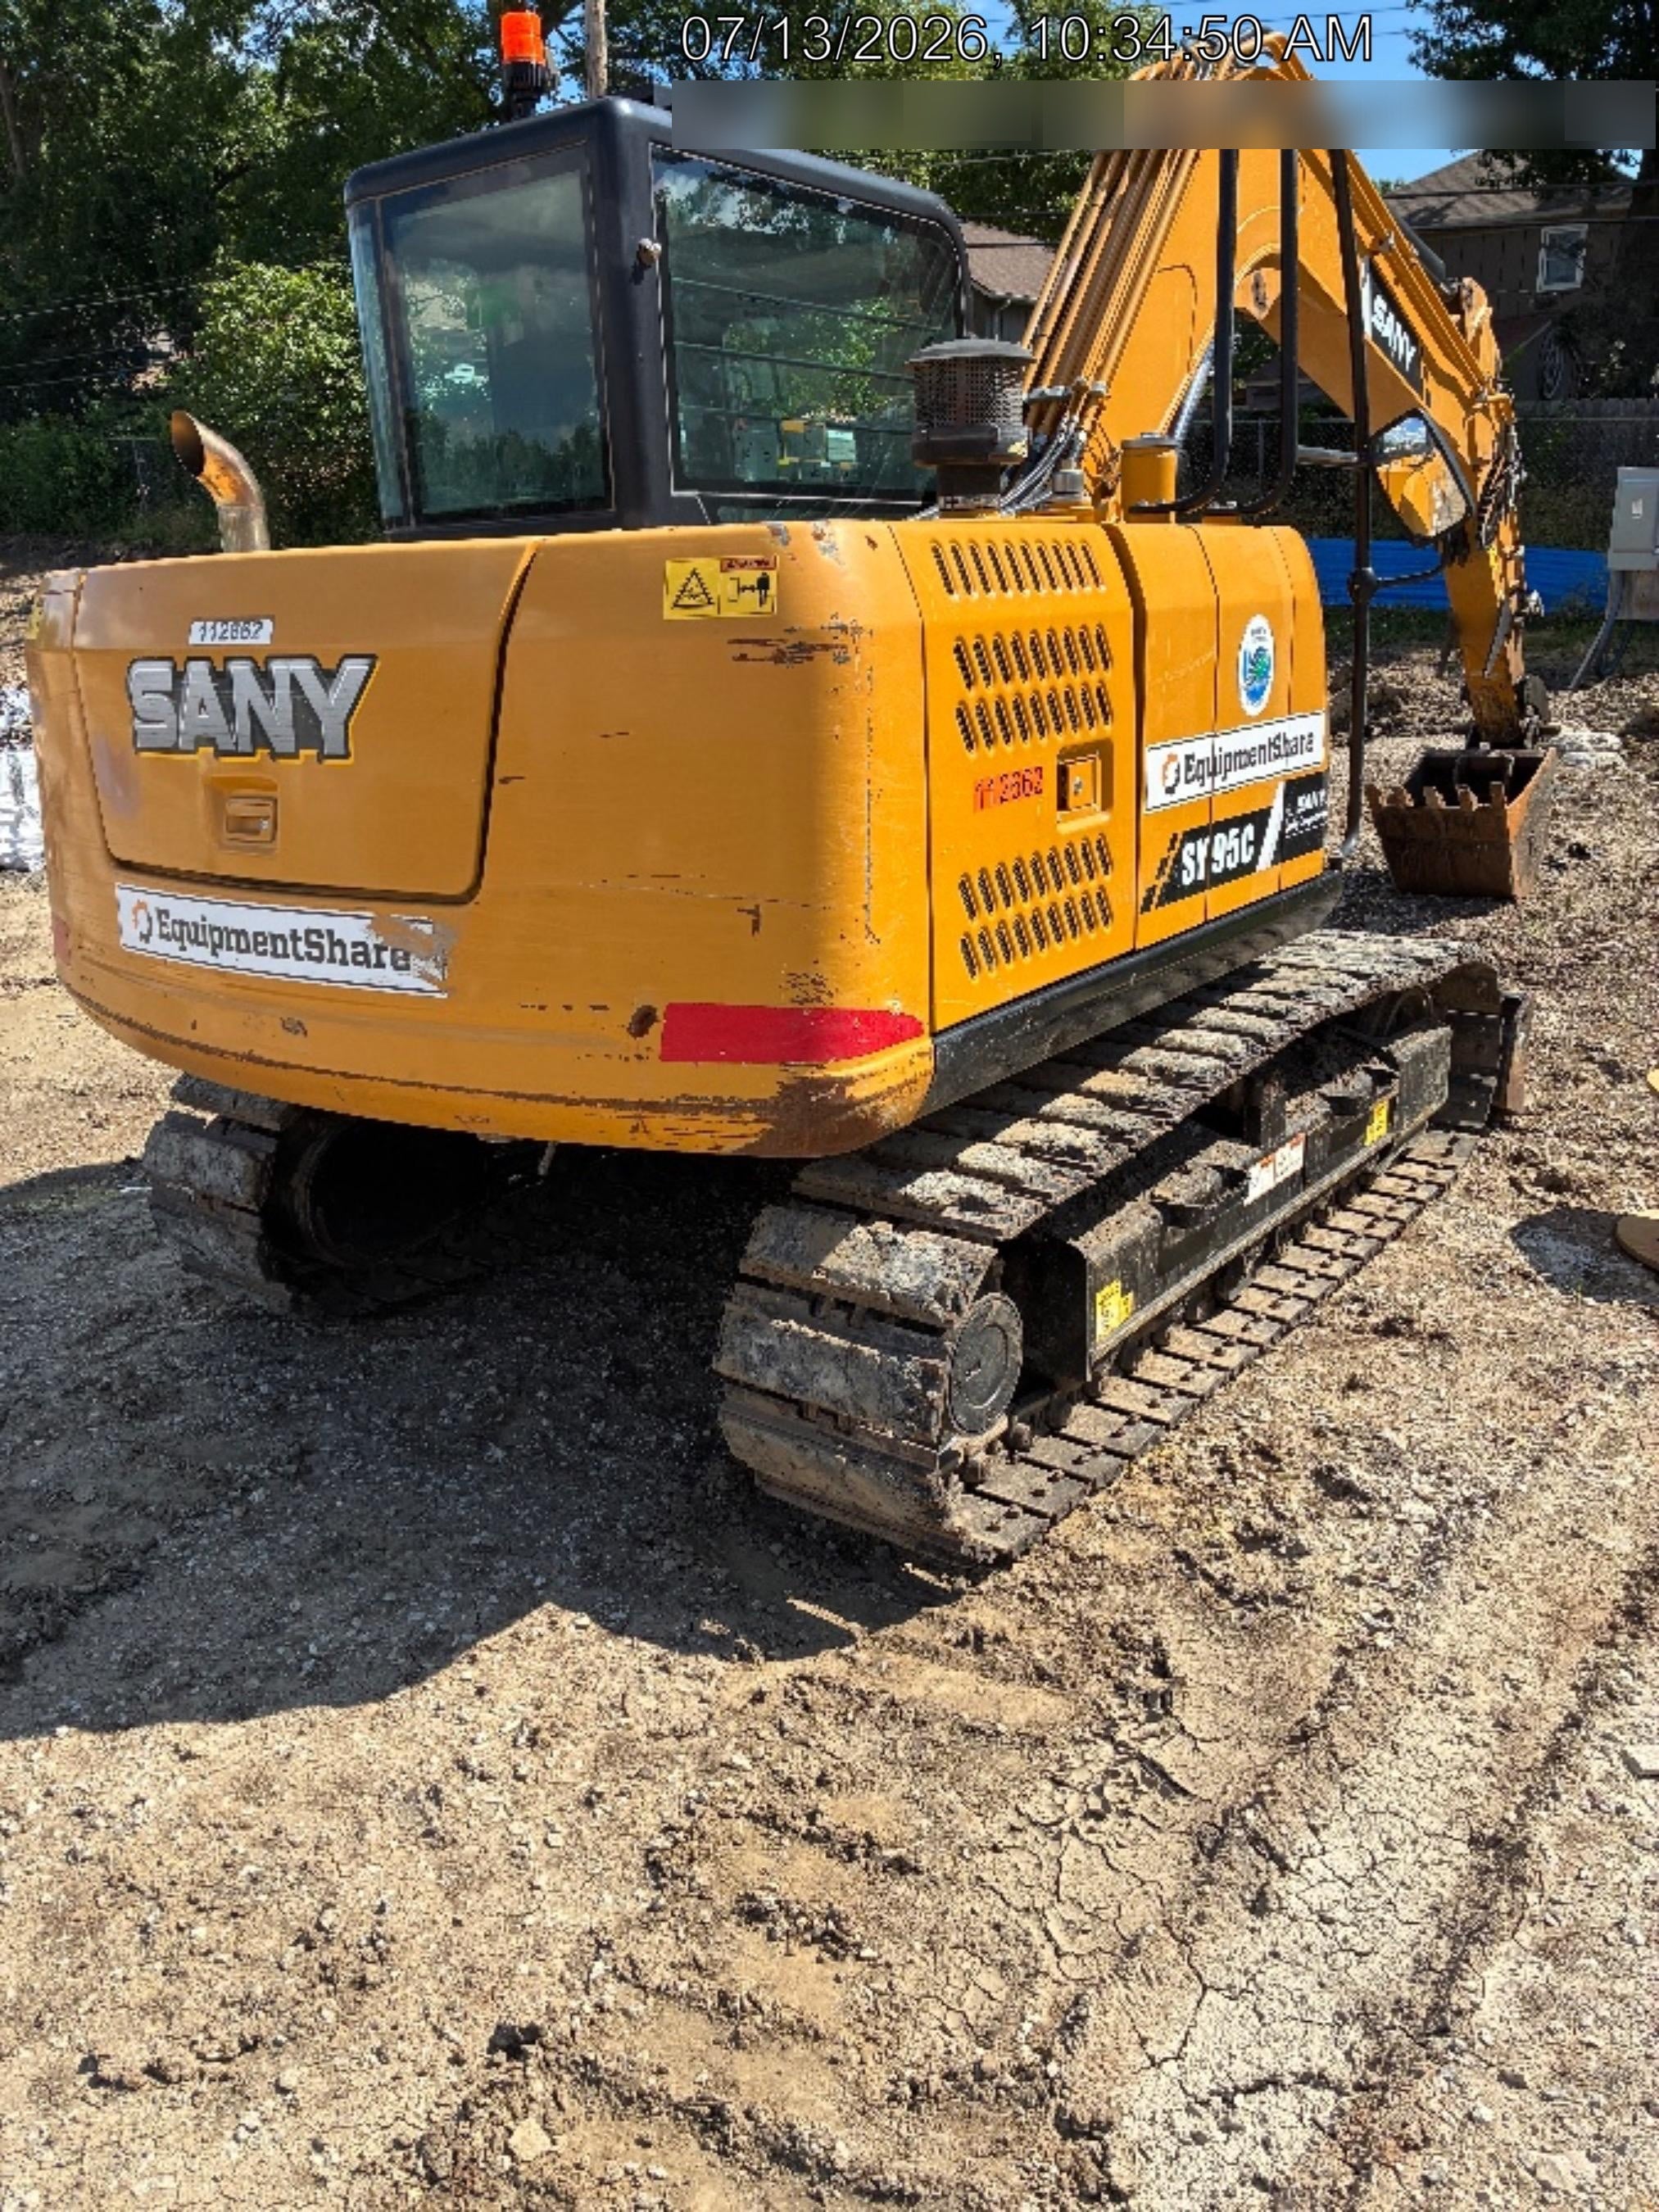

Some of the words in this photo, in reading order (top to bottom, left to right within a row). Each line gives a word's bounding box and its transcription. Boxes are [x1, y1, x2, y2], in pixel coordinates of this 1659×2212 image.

[1371, 294, 1416, 371] SANY
[127, 654, 378, 764] SANY
[1184, 732, 1314, 787] EquipmentShare
[156, 909, 411, 971] EquipmentShare
